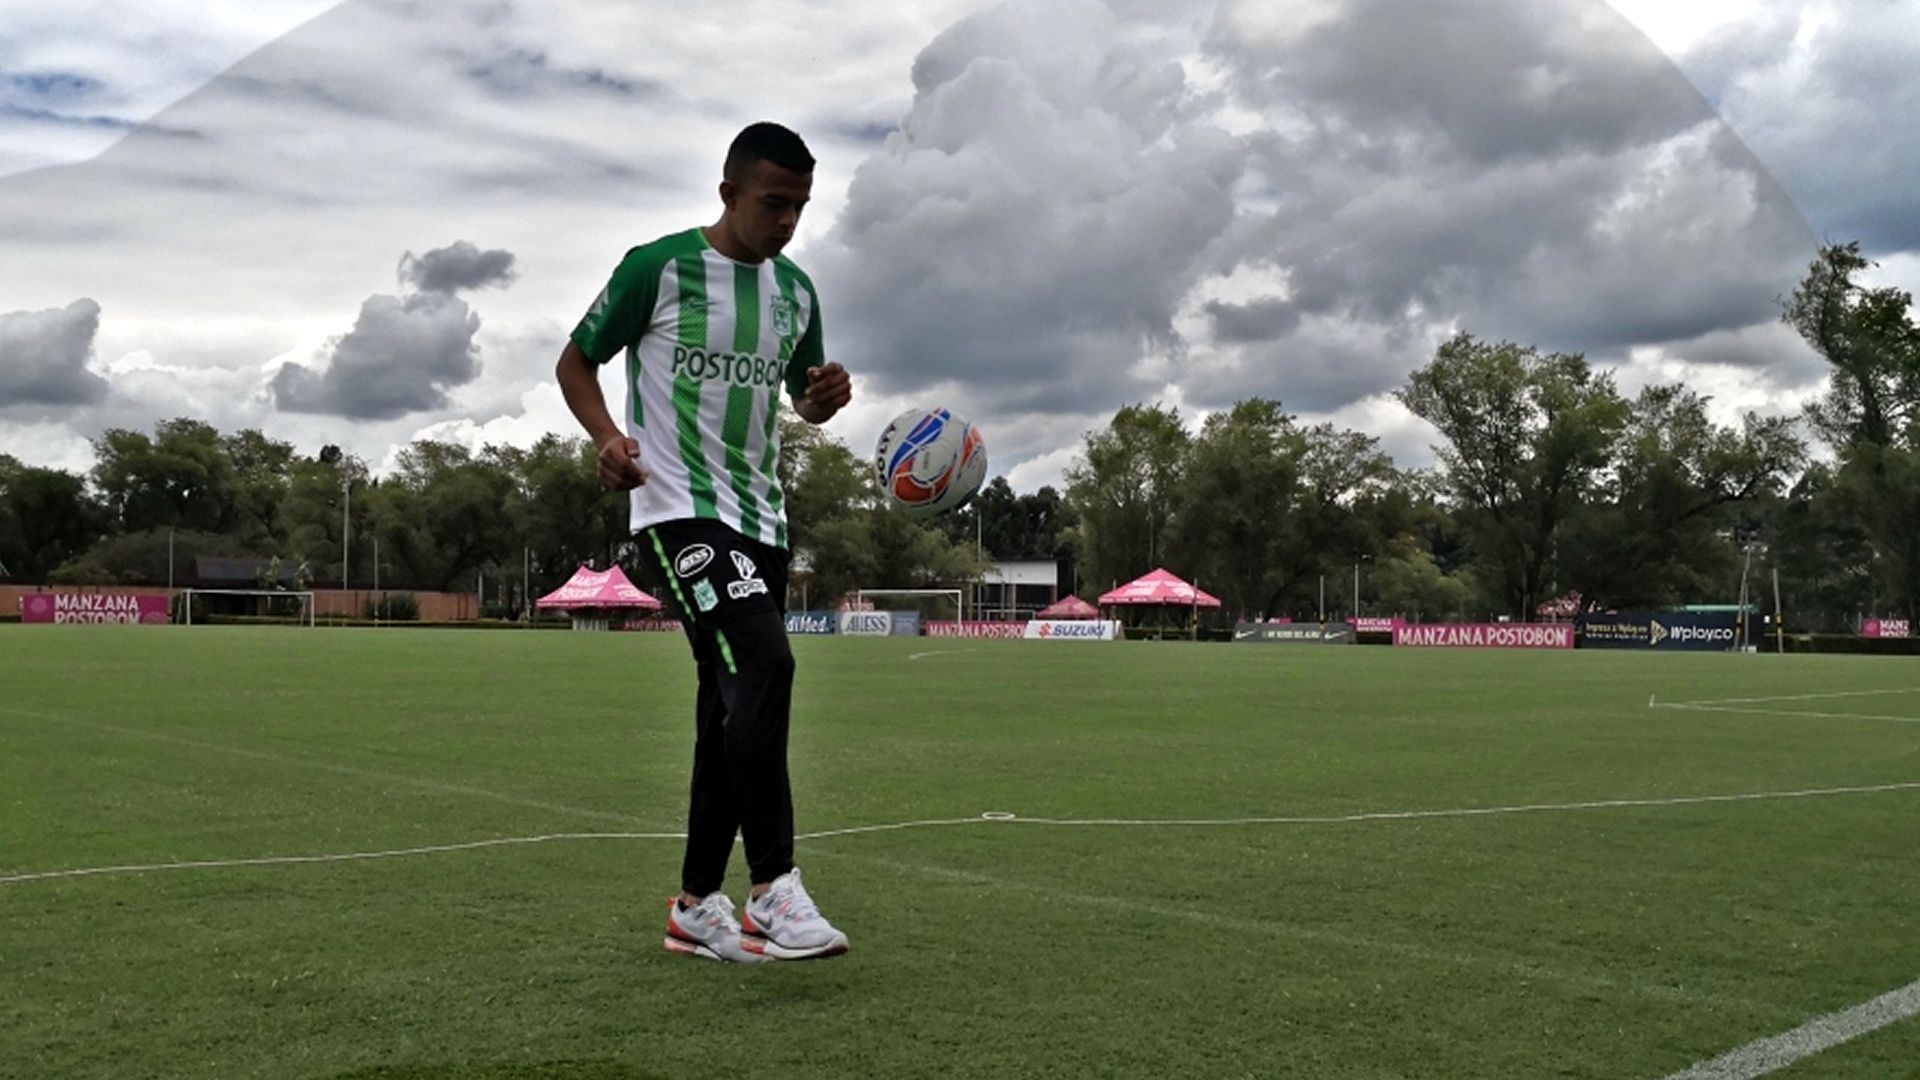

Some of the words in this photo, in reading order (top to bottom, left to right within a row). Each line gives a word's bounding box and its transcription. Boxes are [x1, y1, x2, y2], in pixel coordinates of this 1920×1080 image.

[54, 593, 139, 610] MANZANA
[54, 611, 139, 624] POSTOBON
[1053, 623, 1106, 636] SUZUKI
[1398, 626, 1484, 645] MANZANA
[1486, 627, 1567, 645] POSTOBON
[1670, 625, 1734, 641] Wplay.co
